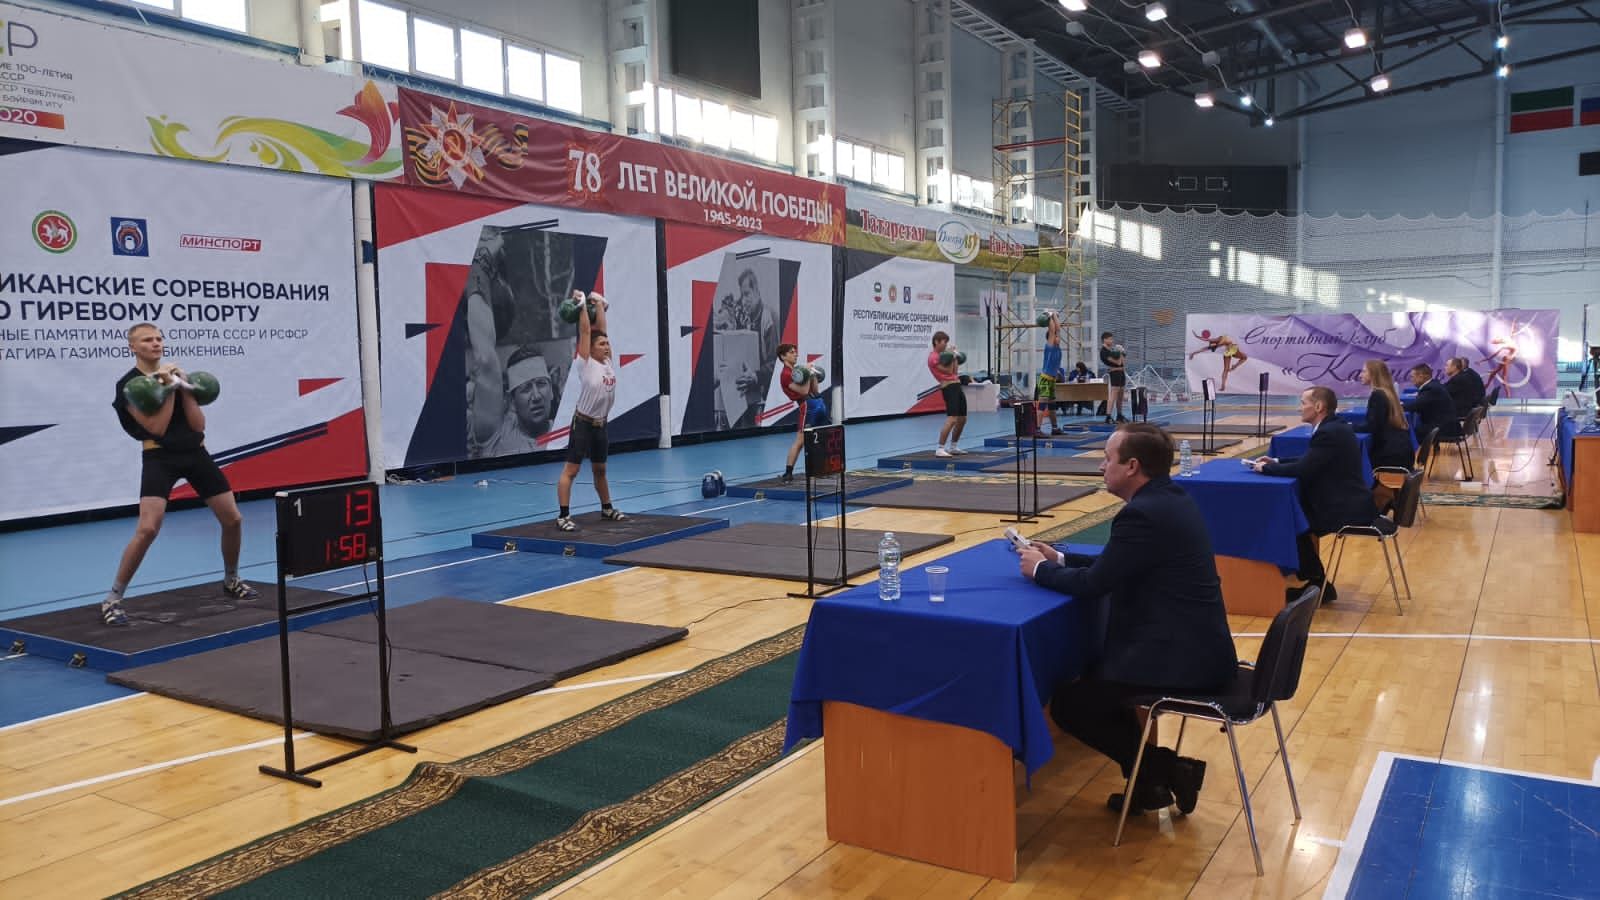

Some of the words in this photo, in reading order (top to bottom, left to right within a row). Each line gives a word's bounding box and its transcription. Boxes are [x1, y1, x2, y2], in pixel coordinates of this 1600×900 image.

[0, 71, 25, 81] ССР
[16, 63, 73, 80] 100-ЛЕТИЯ
[568, 149, 601, 193] 78
[617, 161, 658, 194] ЛЕТ
[665, 169, 756, 212] ВЕЛИКОЙ
[761, 191, 833, 228] ПОБЕДЫ!
[704, 208, 762, 231] 1945-2023
[859, 207, 927, 243] Татарстан
[182, 236, 260, 250] МИНСПОРТ
[0, 273, 146, 296] ИКАНСКИЕ
[152, 278, 329, 301] СОРЕВНОВАНИЯ
[20, 300, 163, 321] ГИРЕВОМУ
[170, 303, 260, 323] СПОРТУ
[34, 328, 97, 341] ПАМЯТИ
[168, 328, 220, 341] СПОРТА
[223, 328, 256, 340] СССР
[259, 329, 267, 340] И
[270, 328, 309, 340] РСФСР
[1244, 325, 1346, 350] Спортивный
[1348, 328, 1397, 351] клуб
[162, 345, 245, 358] БИККЕНИЕВА
[813, 431, 820, 444] 2
[293, 497, 303, 517] 1
[345, 488, 373, 528] 13
[325, 533, 367, 564] 1:58
